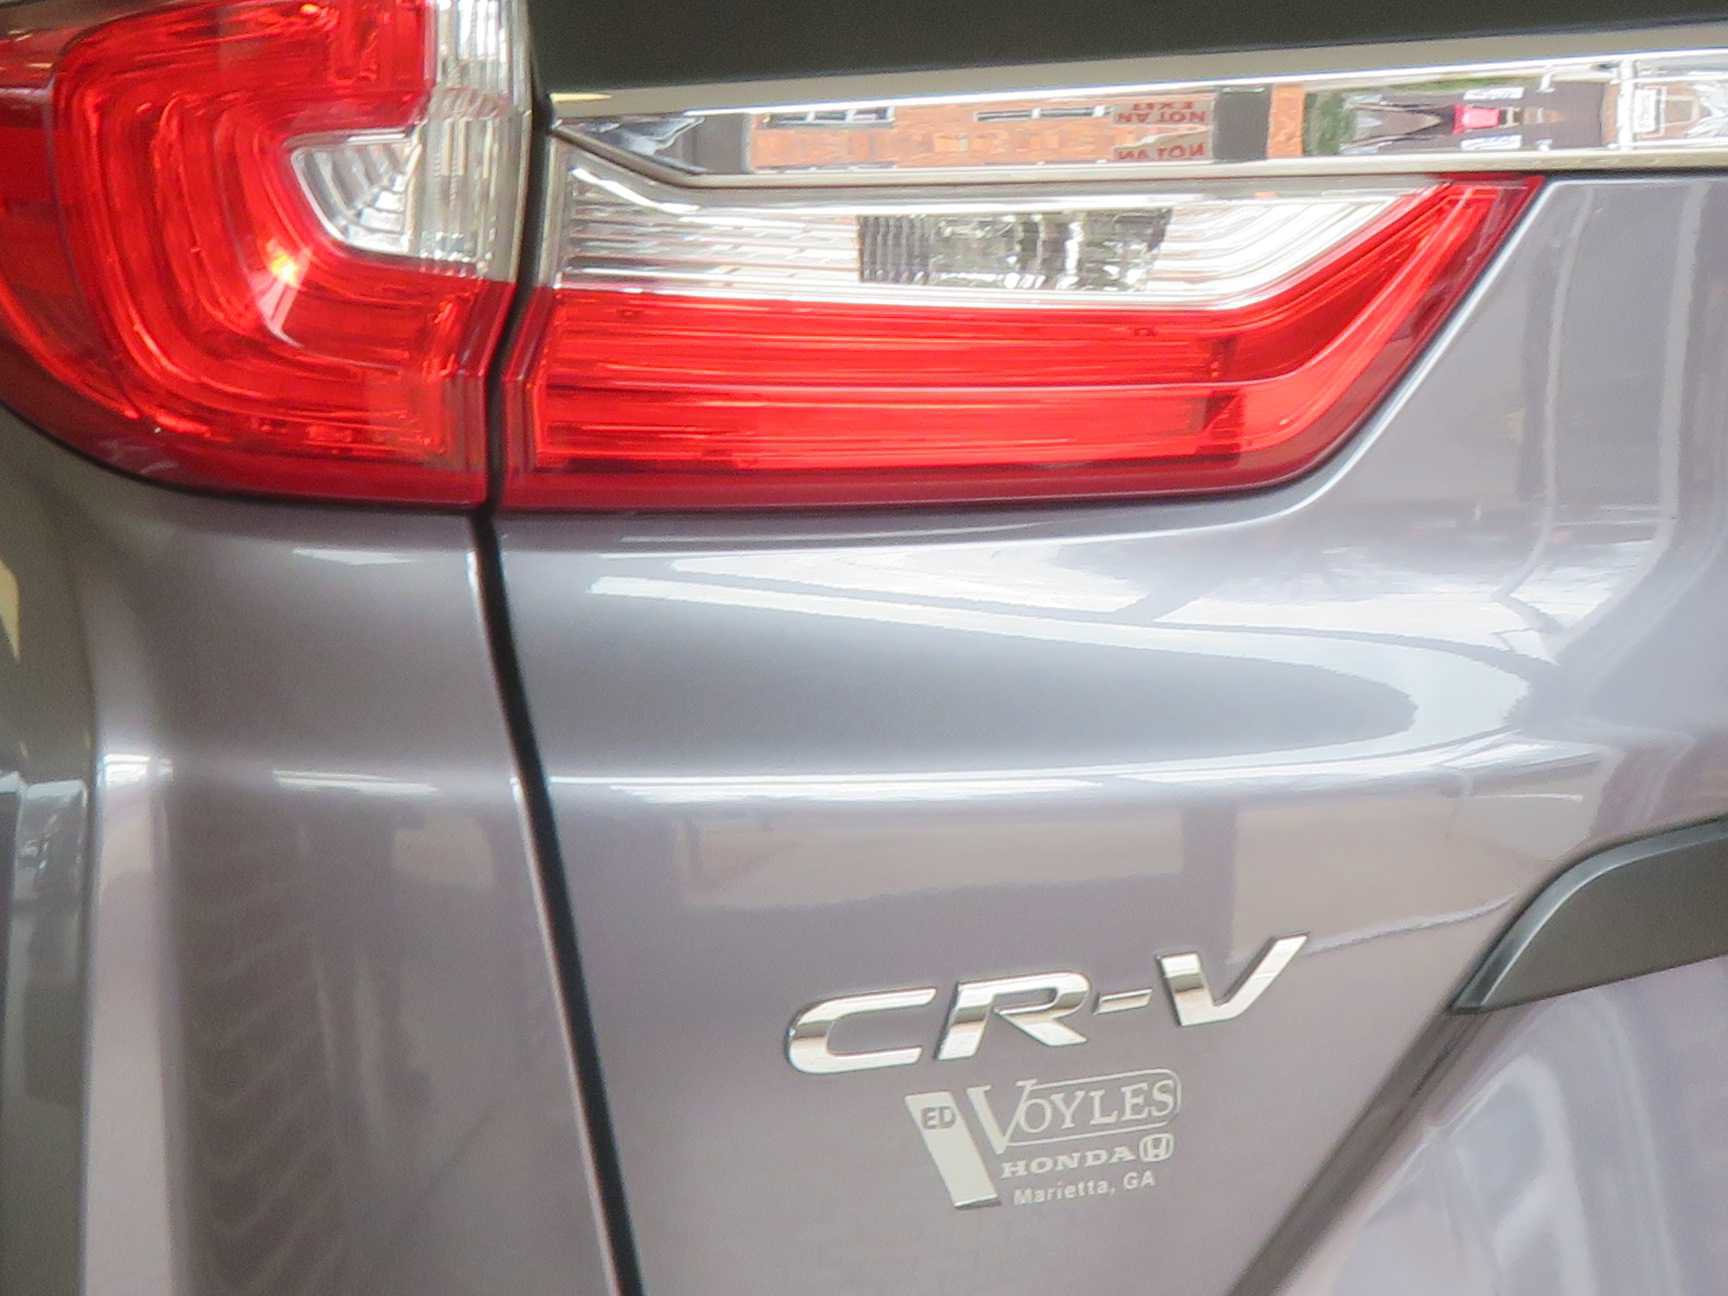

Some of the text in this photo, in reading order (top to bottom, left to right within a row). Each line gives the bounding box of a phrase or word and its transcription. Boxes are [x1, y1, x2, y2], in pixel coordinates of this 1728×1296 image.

[788, 934, 1308, 1074] CR-V
[920, 1106, 958, 1130] ED
[1000, 1145, 1136, 1179] HONDA
[1013, 1170, 1156, 1205] Marietta, GA
